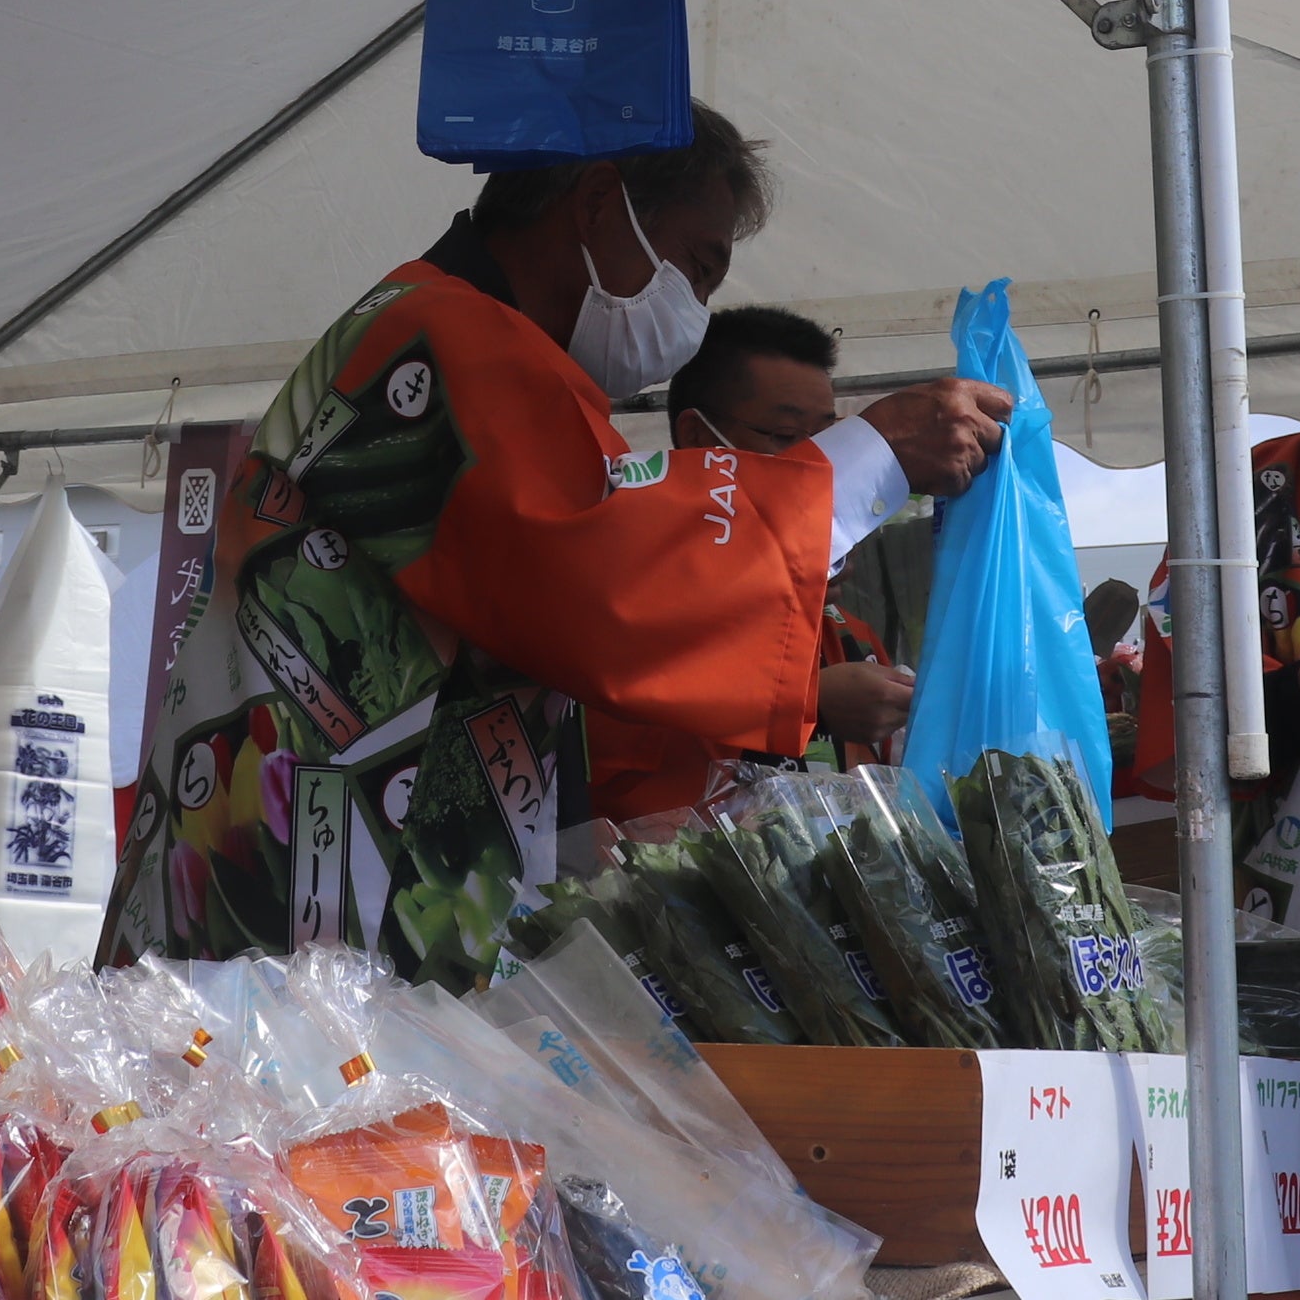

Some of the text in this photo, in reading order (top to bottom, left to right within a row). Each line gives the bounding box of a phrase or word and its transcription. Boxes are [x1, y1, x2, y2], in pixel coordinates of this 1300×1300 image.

[943, 946, 994, 1008] ほ
[1029, 1085, 1071, 1121] トマト
[1021, 1193, 1092, 1268] ¥200
